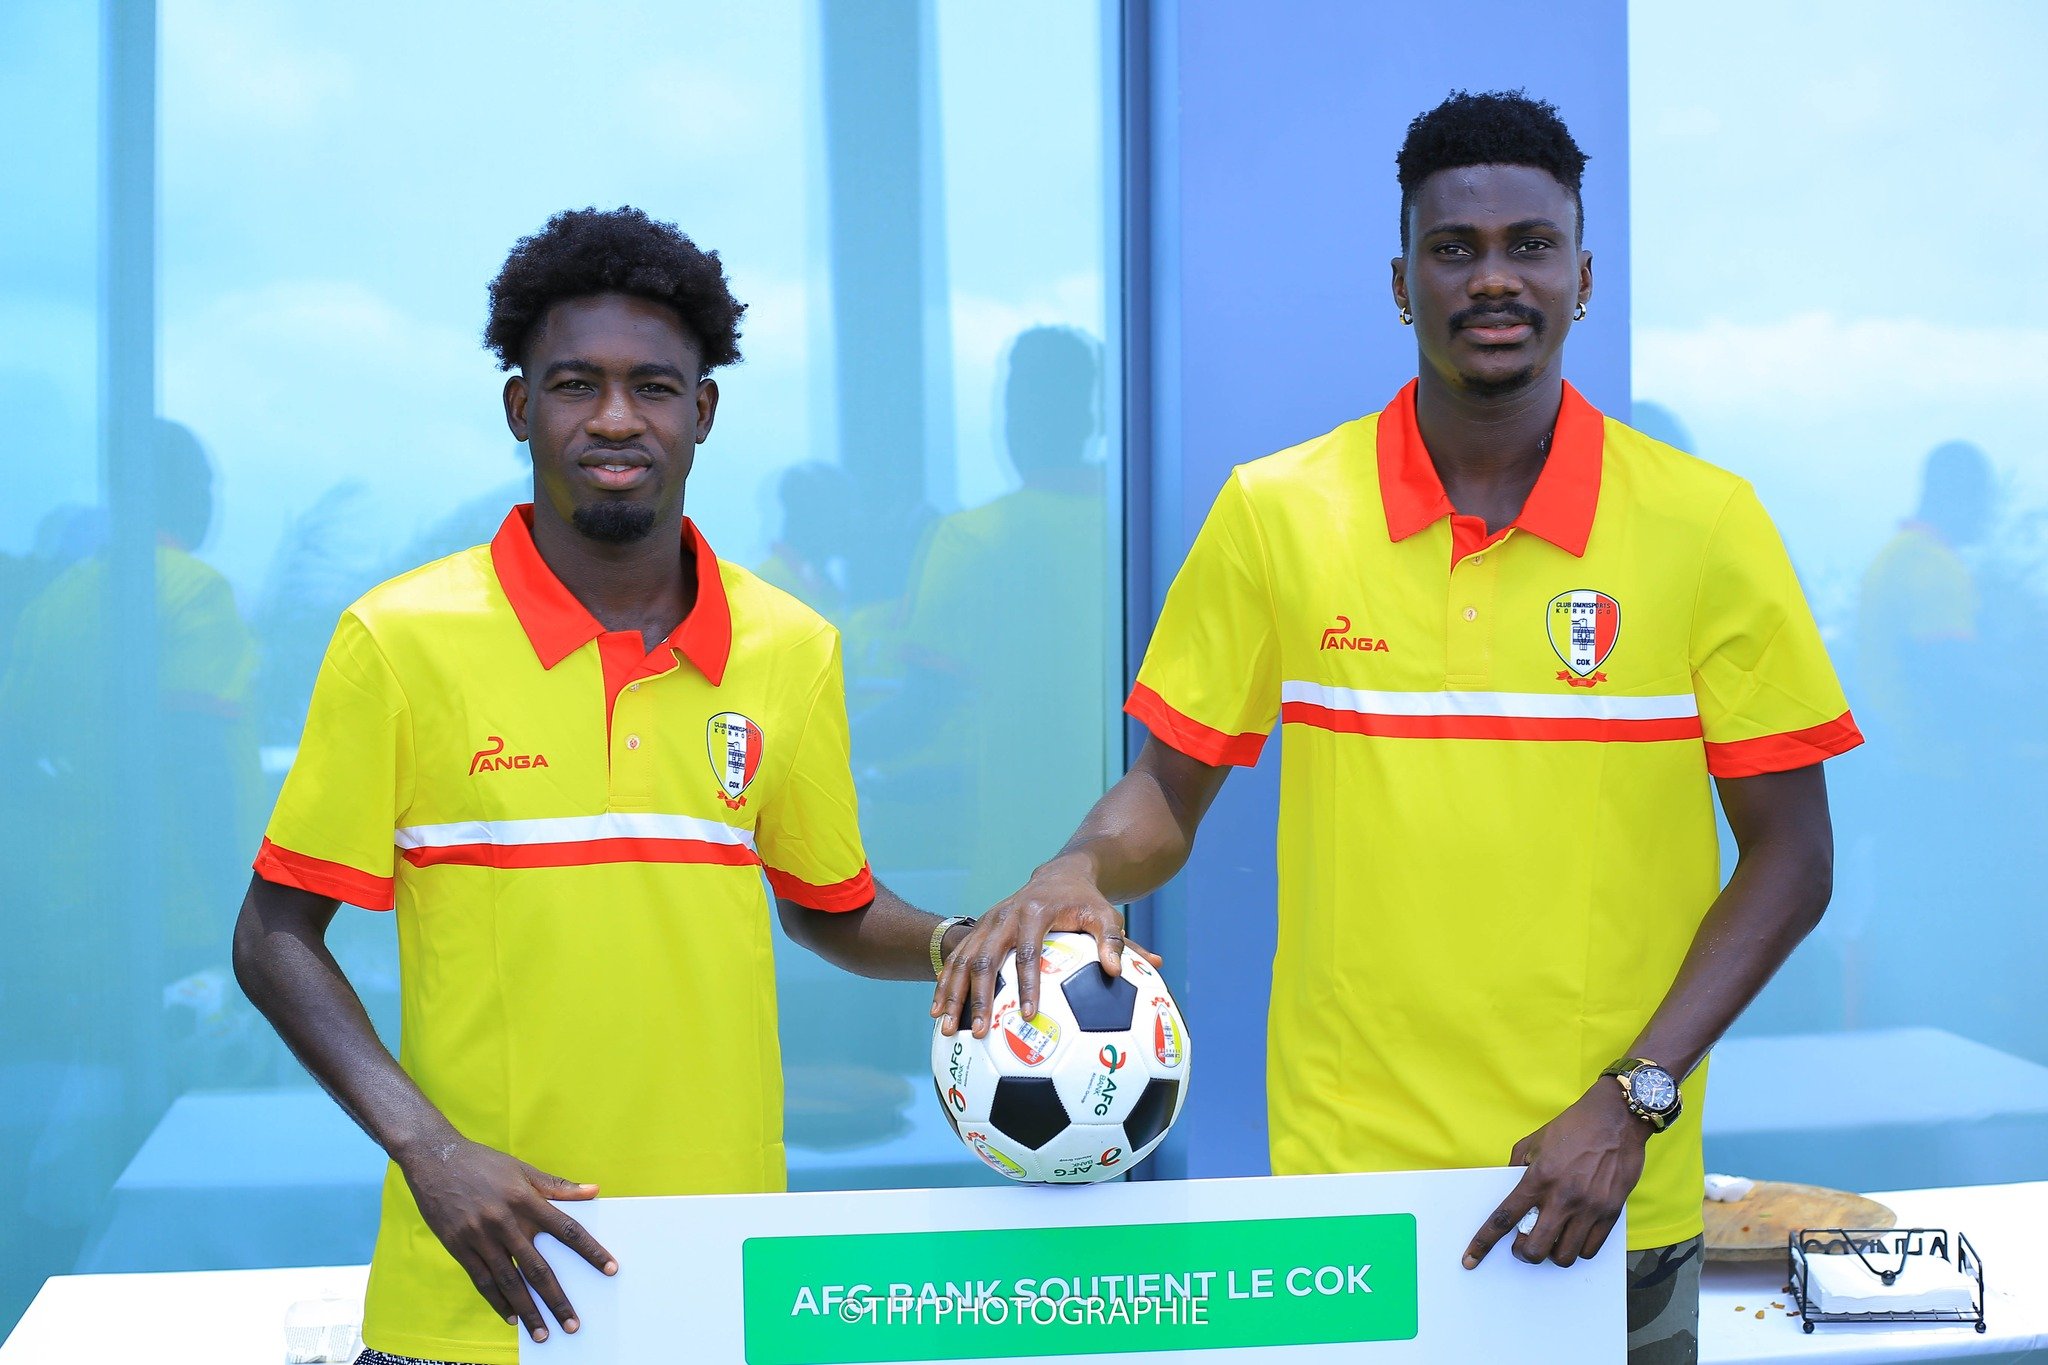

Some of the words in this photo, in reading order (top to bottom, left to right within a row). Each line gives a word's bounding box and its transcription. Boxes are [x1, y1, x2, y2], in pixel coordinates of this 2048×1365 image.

[1320, 616, 1390, 652] PANGA
[1576, 658, 1591, 666] COK
[468, 736, 549, 776] PANGA
[728, 780, 740, 789] COK
[949, 1042, 963, 1081] AFG
[1093, 1074, 1107, 1097] BANK
[1094, 1077, 1117, 1116] AFG
[1053, 1164, 1093, 1177] AFG
[791, 1284, 873, 1316] AFG
[889, 1279, 1002, 1313] BANK
[1014, 1271, 1217, 1308] SOUTIENT
[1228, 1268, 1274, 1299] LE
[1286, 1264, 1373, 1297] COK
